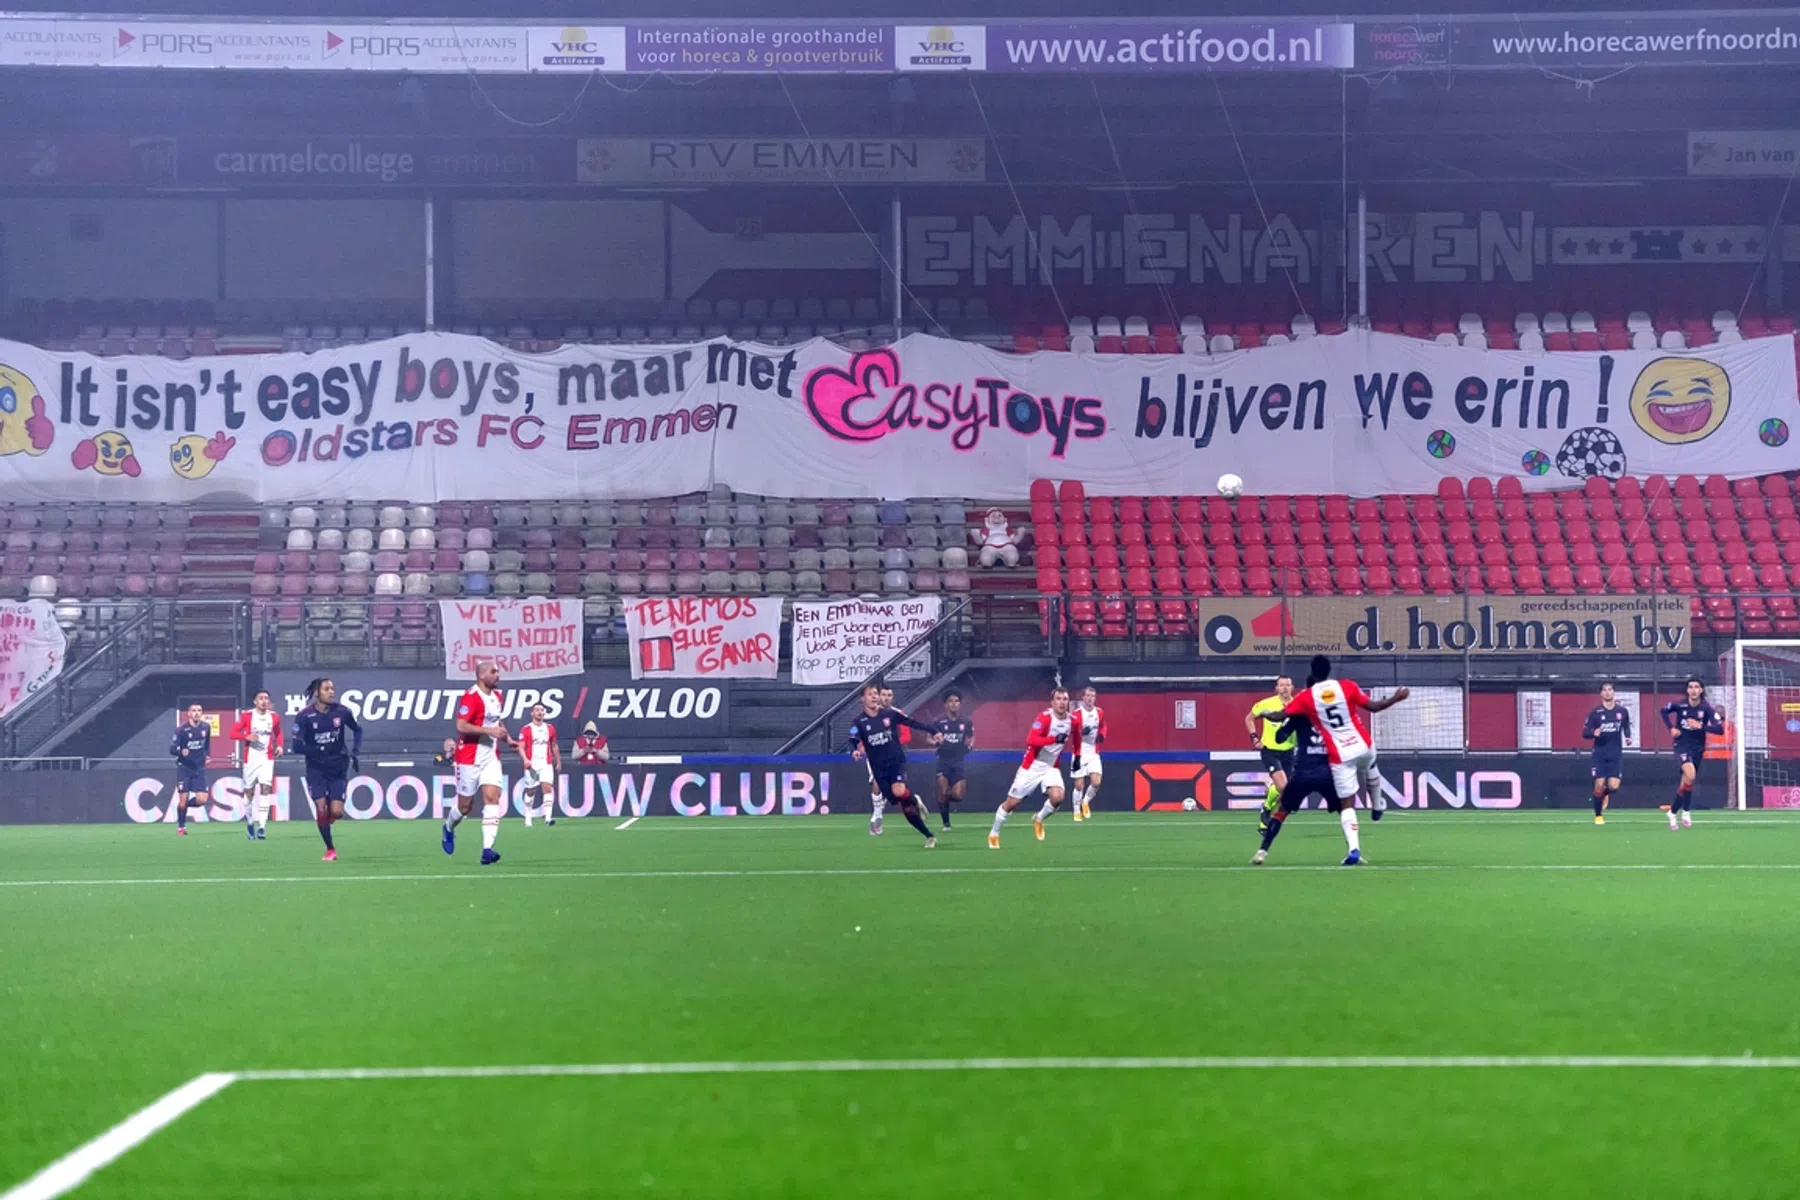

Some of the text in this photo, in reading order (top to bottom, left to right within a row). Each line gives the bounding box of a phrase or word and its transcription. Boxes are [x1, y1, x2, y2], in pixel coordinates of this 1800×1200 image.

[5, 32, 102, 44] ACCOUNTANTS
[142, 34, 312, 54] PORS ACCOUNTANTS
[350, 36, 517, 56] PORS ACCOUNTANTS
[550, 42, 598, 53] VHC
[637, 27, 883, 48] Internationale groothandel
[918, 41, 964, 53] VHC
[1005, 28, 1323, 63] www.actifood.nl
[1492, 27, 1800, 54] www.horecawerfnoordn
[637, 47, 883, 67] voor horeca & grootverbruik
[215, 142, 415, 181] carmelcollege
[650, 142, 919, 168] RTV EMMEN
[1724, 147, 1795, 162] Jan van
[60, 361, 99, 426] It
[115, 367, 246, 431] isn't
[257, 359, 382, 424] easy
[395, 346, 535, 417] boys,
[557, 350, 693, 406] maar
[706, 342, 797, 399] met
[1134, 373, 1328, 449] blijven
[1354, 369, 1434, 432] we
[1454, 365, 1572, 430] erin
[259, 402, 738, 467] Oldstars FC Emmen
[455, 602, 563, 624] WIE BIN
[634, 596, 757, 627] TENEMOS
[795, 607, 821, 623] EEN
[468, 624, 577, 648] NOG NOOIT
[1346, 605, 1686, 652] d. holman bv
[696, 632, 775, 674] GANAR
[340, 687, 565, 721] SCHUTUPS
[597, 686, 722, 720] EXLOO
[1324, 705, 1345, 729] 5
[670, 771, 831, 817] CLUB!
